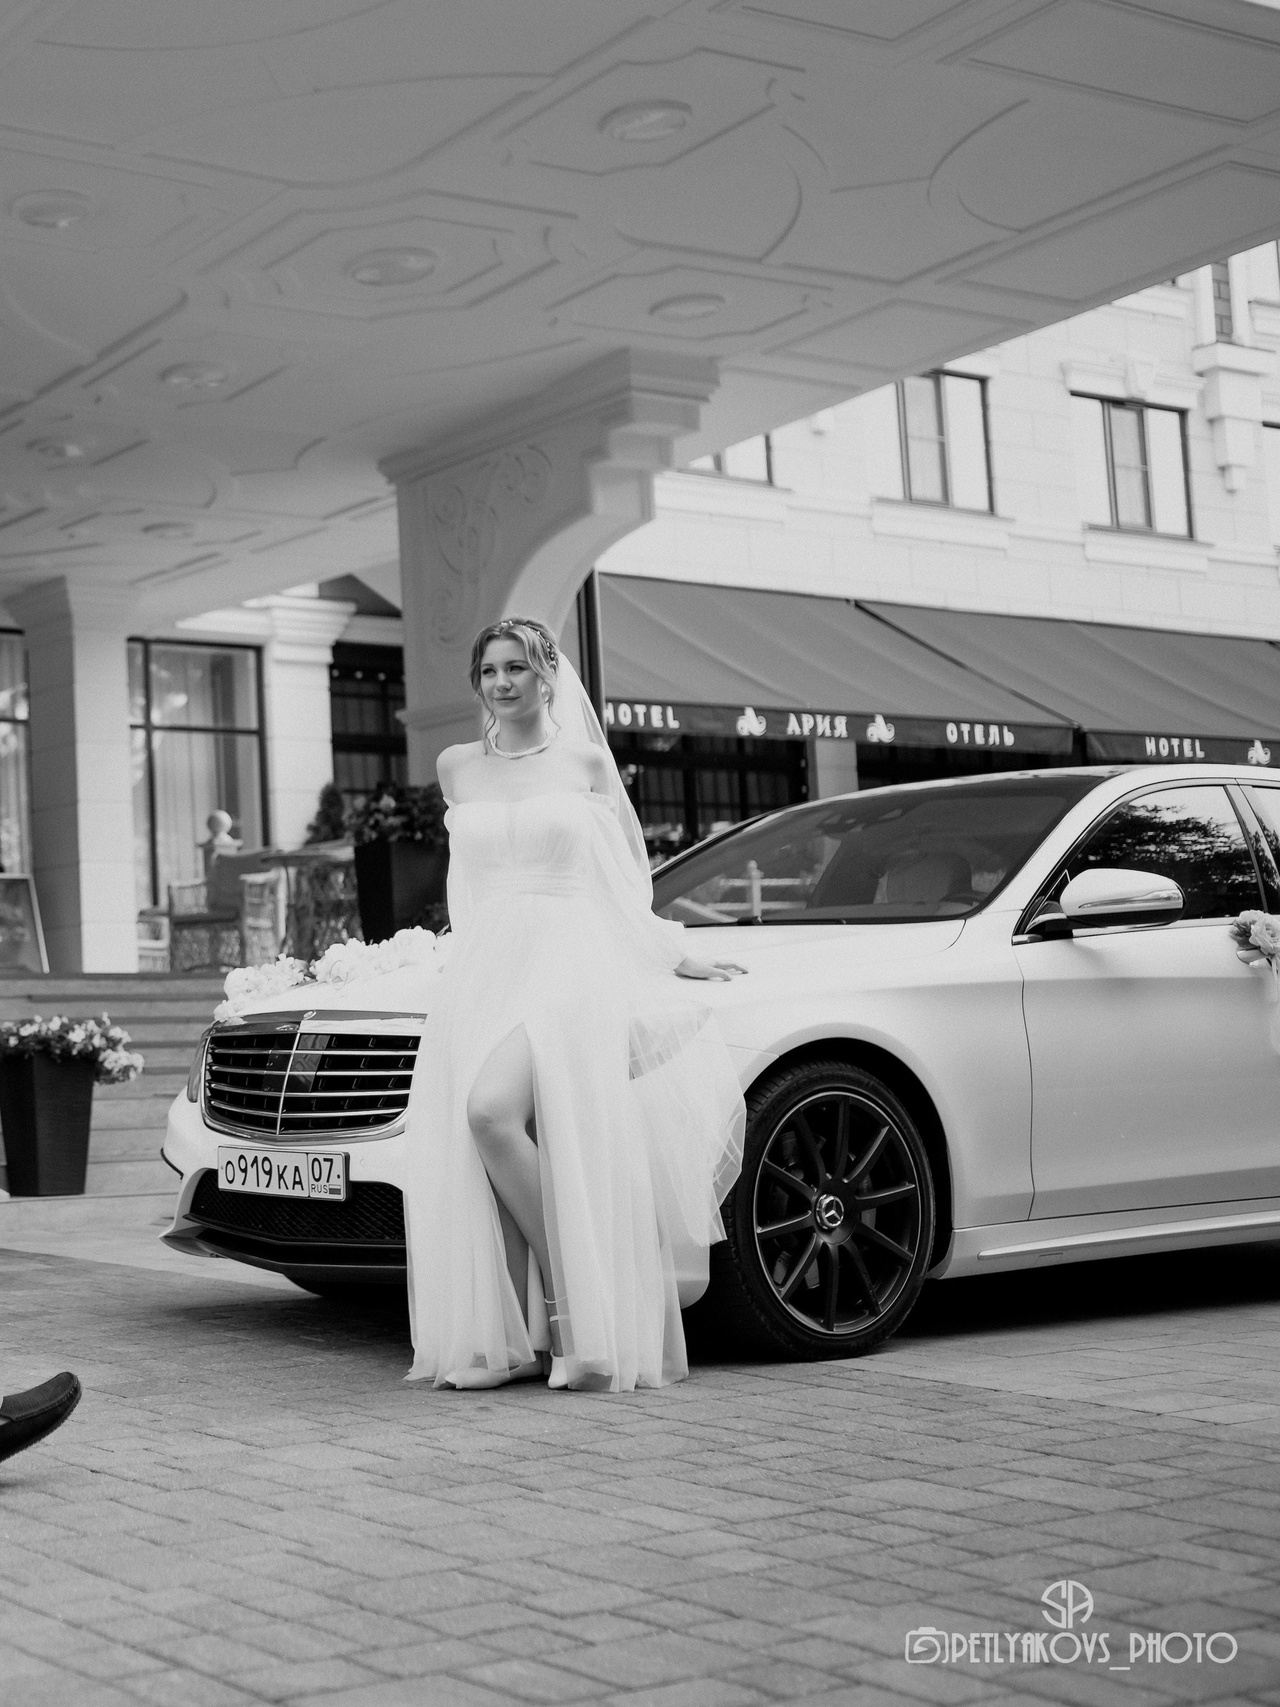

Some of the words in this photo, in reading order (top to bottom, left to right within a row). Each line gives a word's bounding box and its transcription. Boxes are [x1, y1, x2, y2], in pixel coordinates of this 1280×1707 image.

[603, 702, 680, 729] HOTEL
[786, 712, 848, 738] АРИЯ
[946, 722, 1015, 747] ОТЕЛЬ
[1145, 736, 1205, 758] HOTEL
[311, 1183, 328, 1194] RUS
